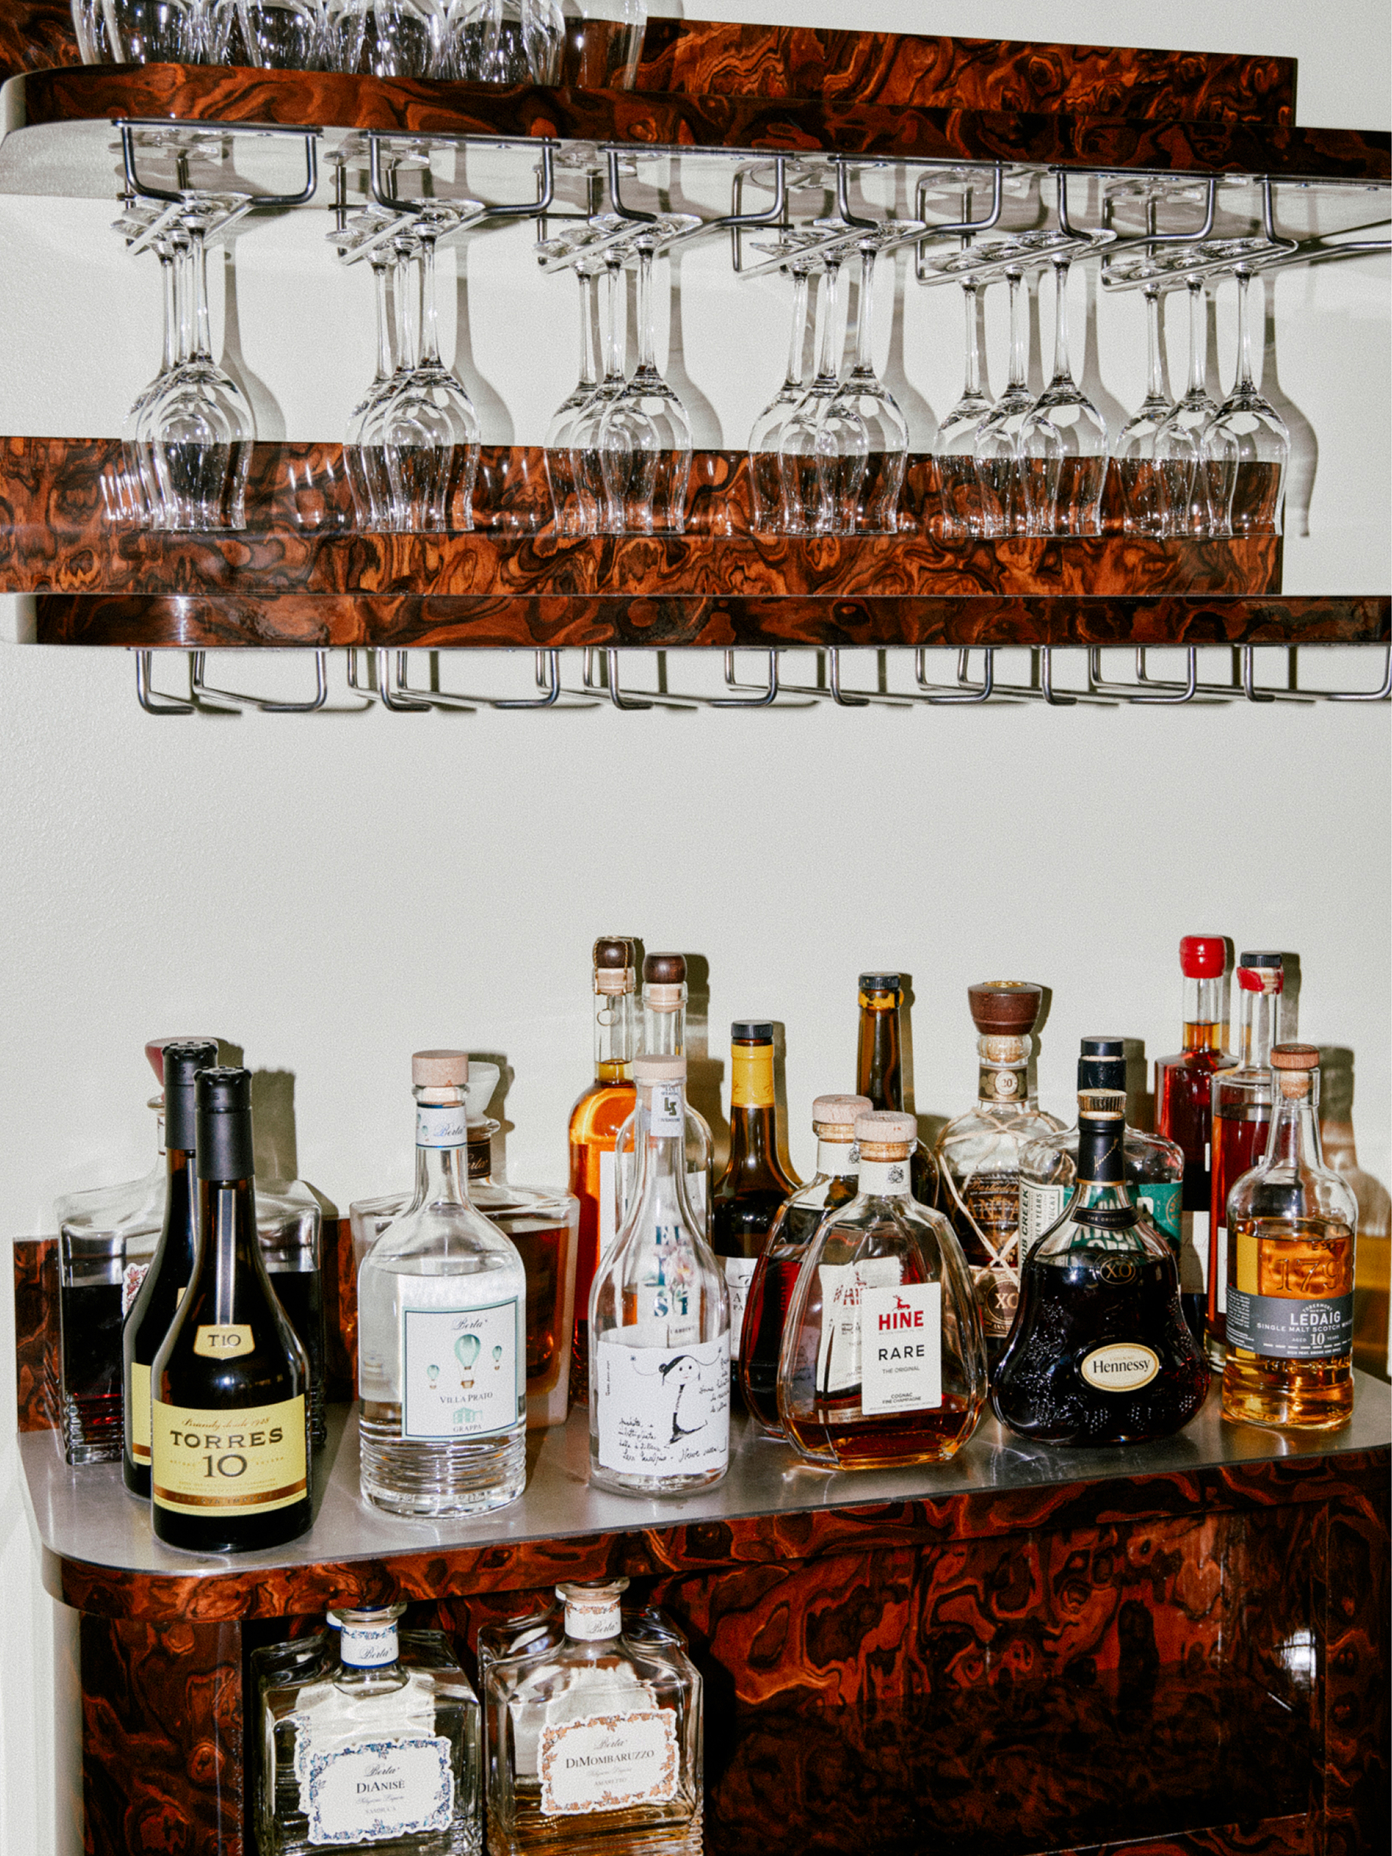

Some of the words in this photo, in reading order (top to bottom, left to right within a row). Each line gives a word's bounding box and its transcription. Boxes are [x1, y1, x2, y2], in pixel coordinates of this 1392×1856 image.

[878, 1310, 925, 1331] HINE
[1290, 1310, 1341, 1326] LEDAIG
[1256, 1322, 1286, 1332] SINGLE
[1312, 1324, 1341, 1333] SCOTCH
[1310, 1332, 1325, 1346] 10
[878, 1344, 925, 1361] RARE
[882, 1367, 894, 1375] THE
[895, 1365, 920, 1374] ORIGINAL
[1093, 1359, 1151, 1374] Hennessy
[439, 1396, 466, 1405] VILLA
[169, 1426, 284, 1450] TORRES
[202, 1453, 248, 1478] 10
